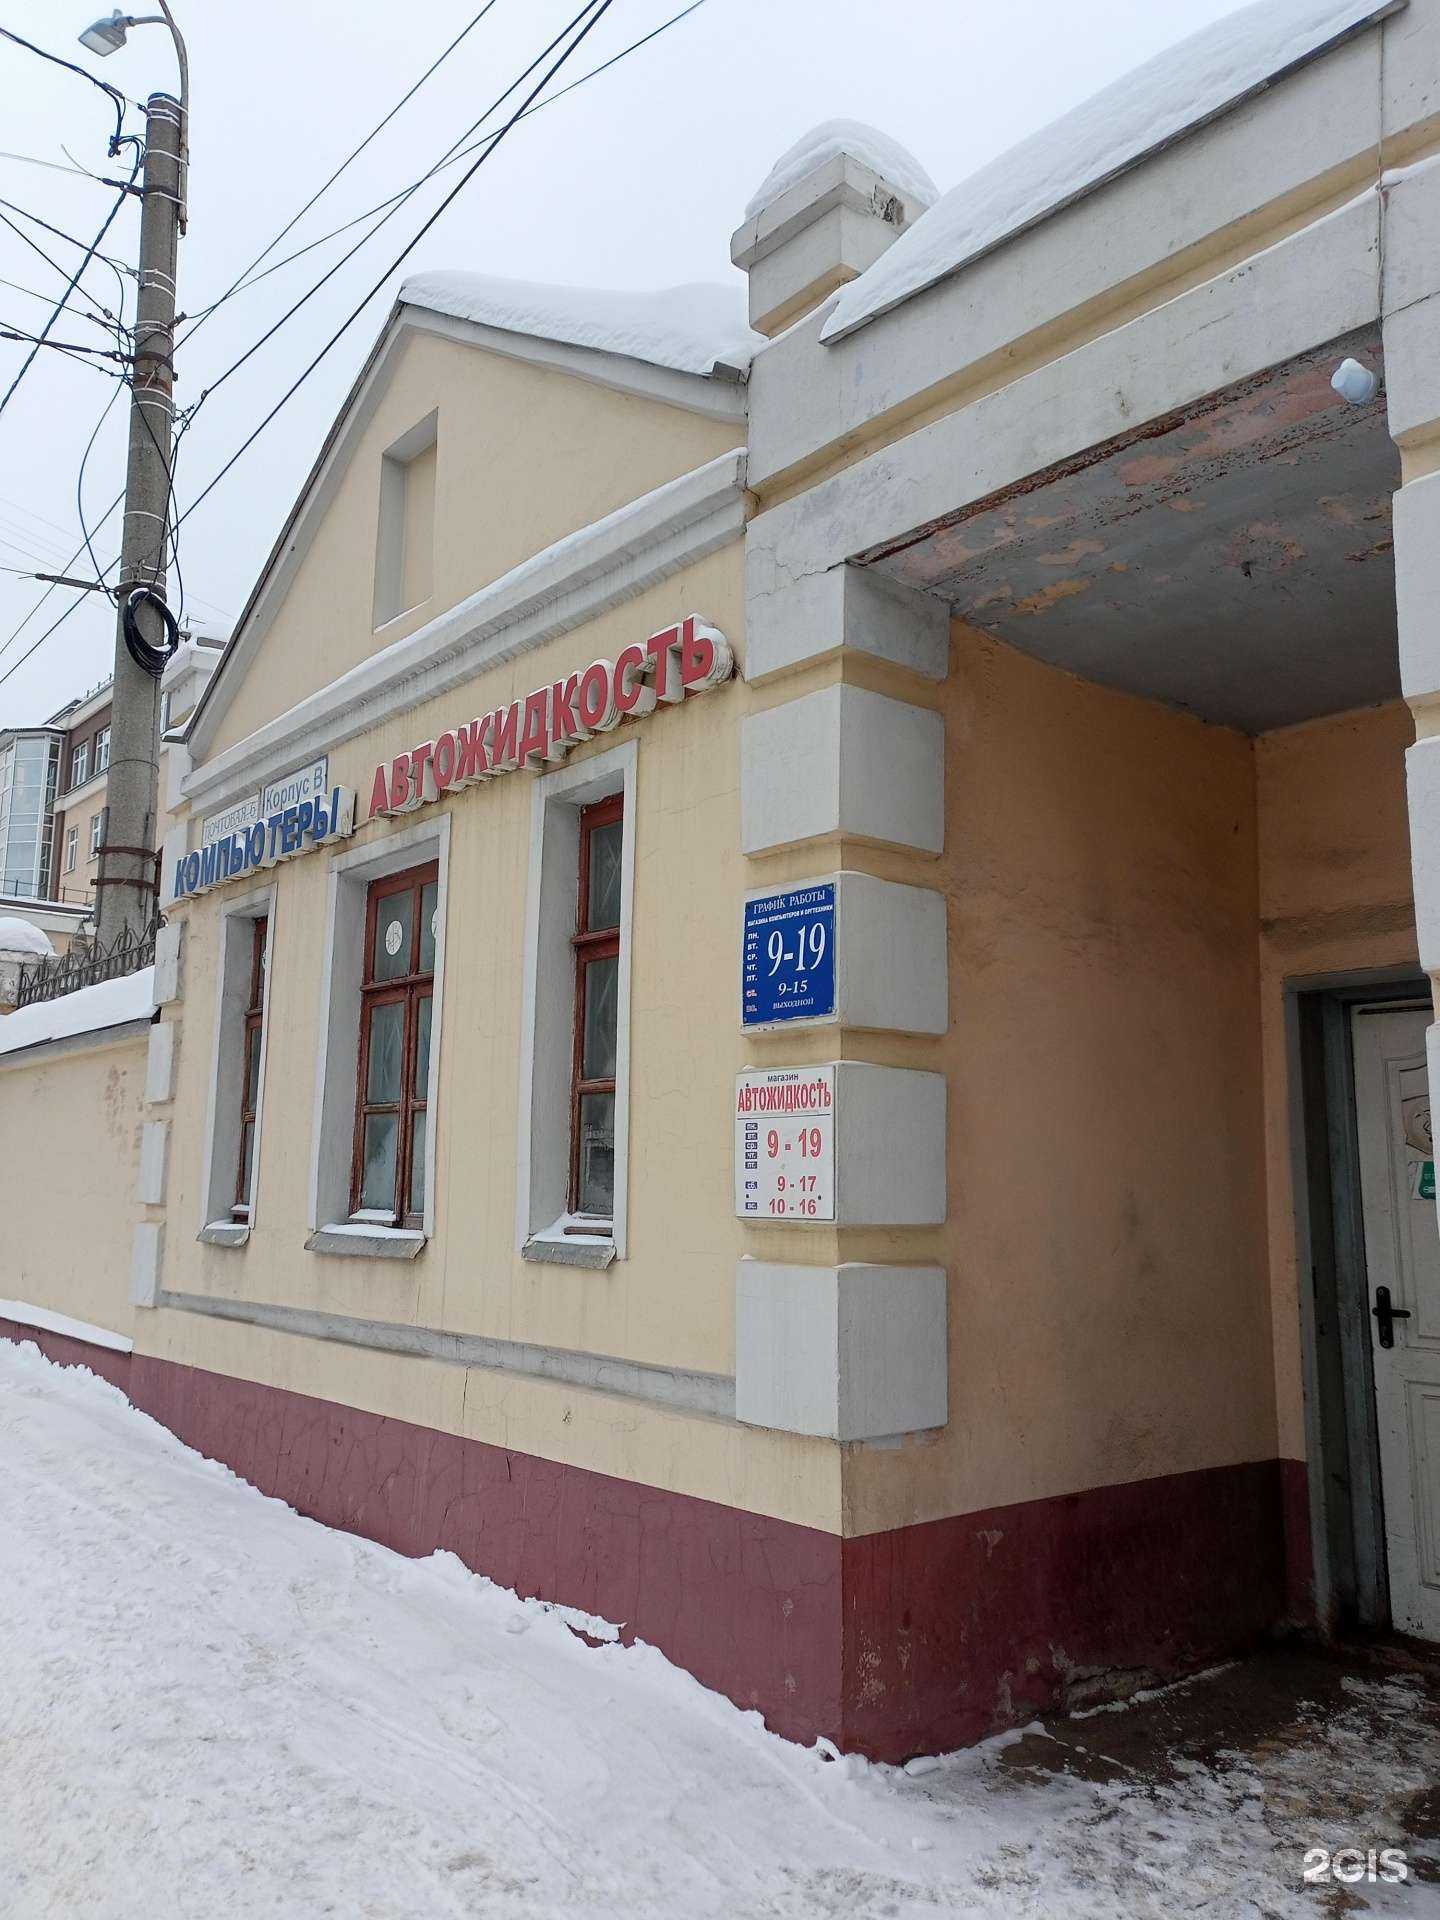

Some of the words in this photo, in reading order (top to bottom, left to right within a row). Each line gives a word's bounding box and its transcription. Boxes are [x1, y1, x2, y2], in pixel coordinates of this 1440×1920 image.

[368, 616, 716, 818] АВТОЖИДКОСТЬ
[265, 777, 310, 812] Корпус
[313, 766, 324, 790] В
[173, 786, 341, 898] КОМПЬЮТЕРЫ
[753, 896, 786, 915] ГРАФИК
[789, 890, 826, 907] РАБОТЫ
[767, 922, 826, 977] 9-19
[778, 980, 808, 996] 9-15
[767, 1073, 799, 1083] магазин
[737, 1082, 832, 1113] АВТОЖИДКОСТЬ
